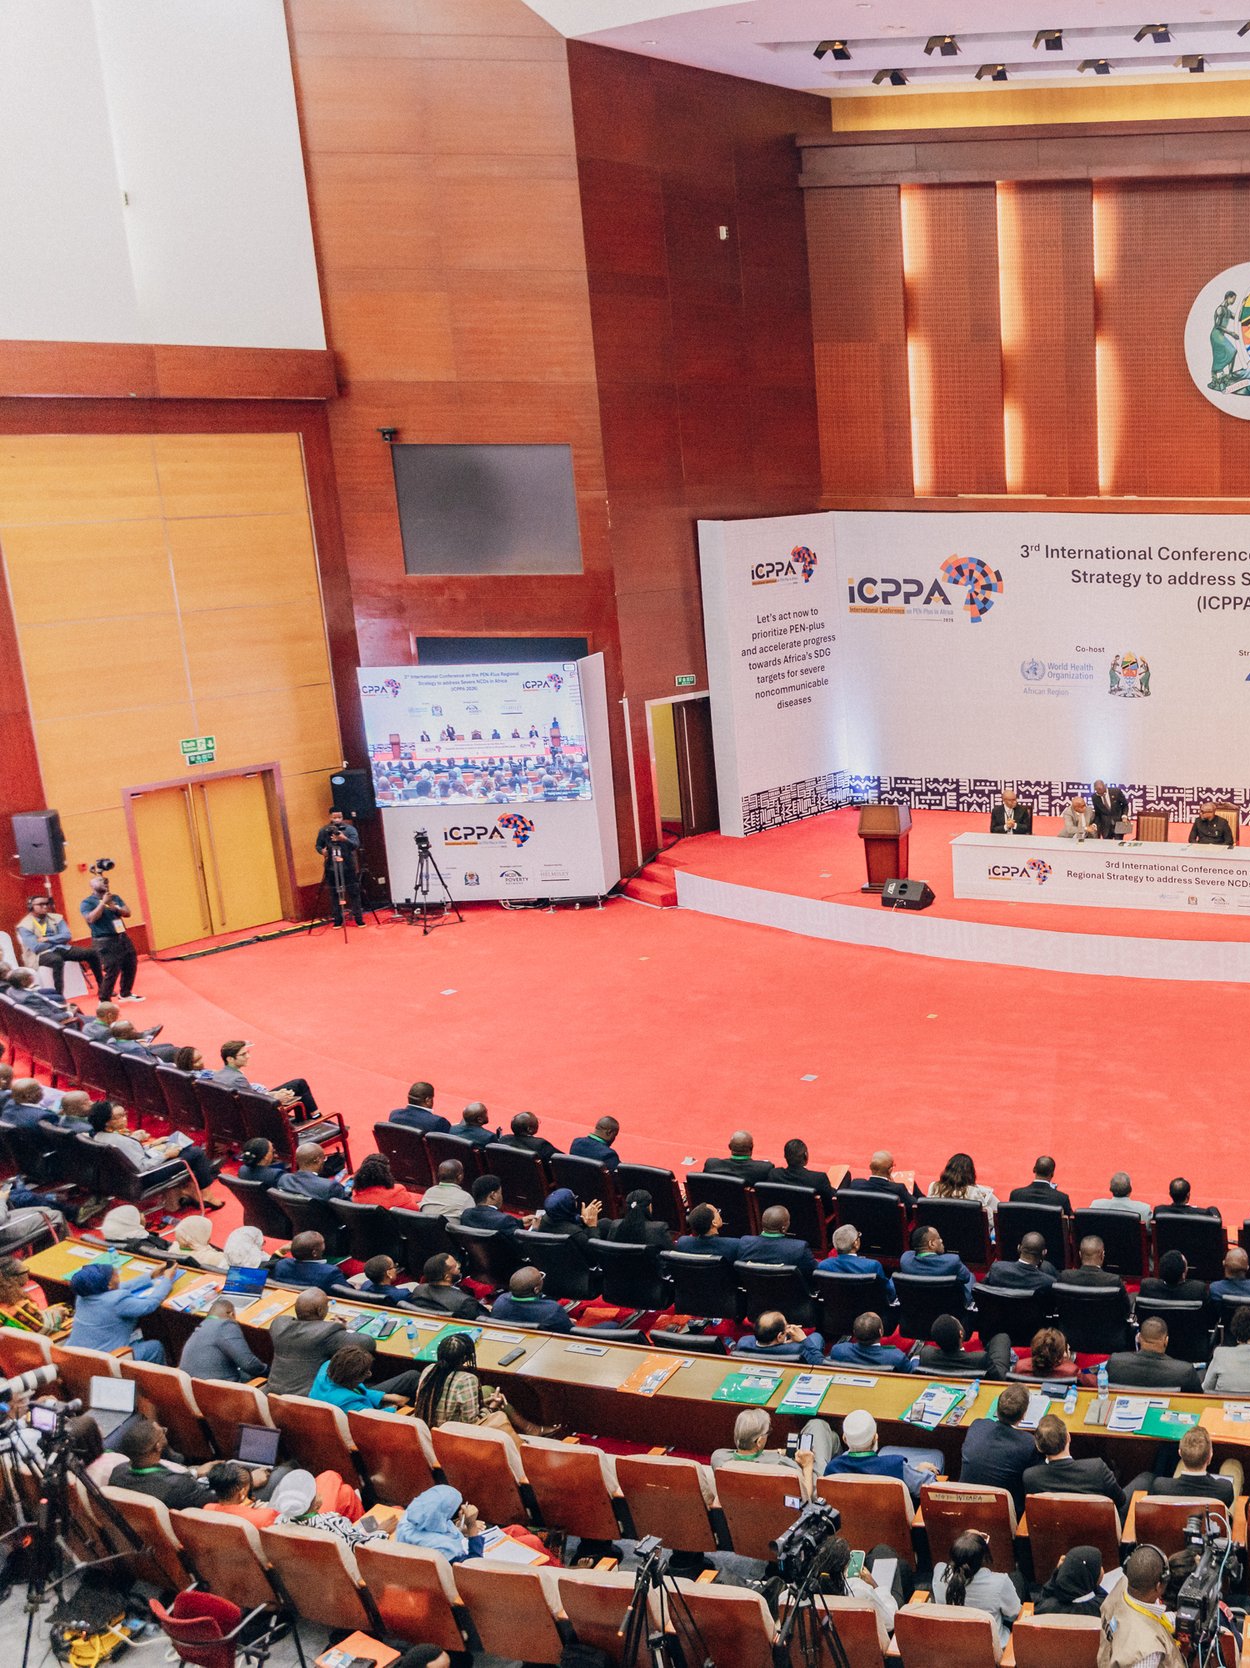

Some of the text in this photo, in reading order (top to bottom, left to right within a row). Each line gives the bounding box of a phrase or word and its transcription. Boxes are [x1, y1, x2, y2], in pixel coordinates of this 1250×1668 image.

[1020, 544, 1040, 558] 3rd
[1045, 545, 1153, 560] International
[751, 560, 797, 580] iCPPA
[1071, 569, 1141, 587] Strategy
[1145, 571, 1162, 585] to
[1167, 571, 1236, 586] address
[847, 577, 951, 606] iCPPA
[778, 612, 791, 621] act
[793, 610, 810, 618] now
[810, 608, 819, 616] to
[751, 621, 825, 642] prioritize PEN-plus
[741, 634, 836, 657] and accelerate progress
[1075, 645, 1105, 653] Co-host
[748, 657, 782, 671] towards
[814, 648, 831, 659] SDG
[1047, 663, 1094, 672] World Health
[757, 664, 826, 685] targets for severe
[1047, 672, 1094, 681] Organization
[755, 678, 829, 700] noncommunicable
[1023, 688, 1069, 697] African Region
[777, 695, 812, 710] diseases
[443, 825, 505, 841] iCPPA
[988, 865, 1030, 878] iCPPA
[1105, 860, 1120, 869] 3rd
[1122, 861, 1179, 872] International
[1181, 864, 1234, 875] Conference
[1236, 868, 1248, 876] on
[1067, 870, 1105, 881] Regional
[1106, 872, 1144, 884] Strategy
[1146, 875, 1154, 883] to
[1157, 875, 1193, 885] address
[1195, 877, 1226, 888] Severe
